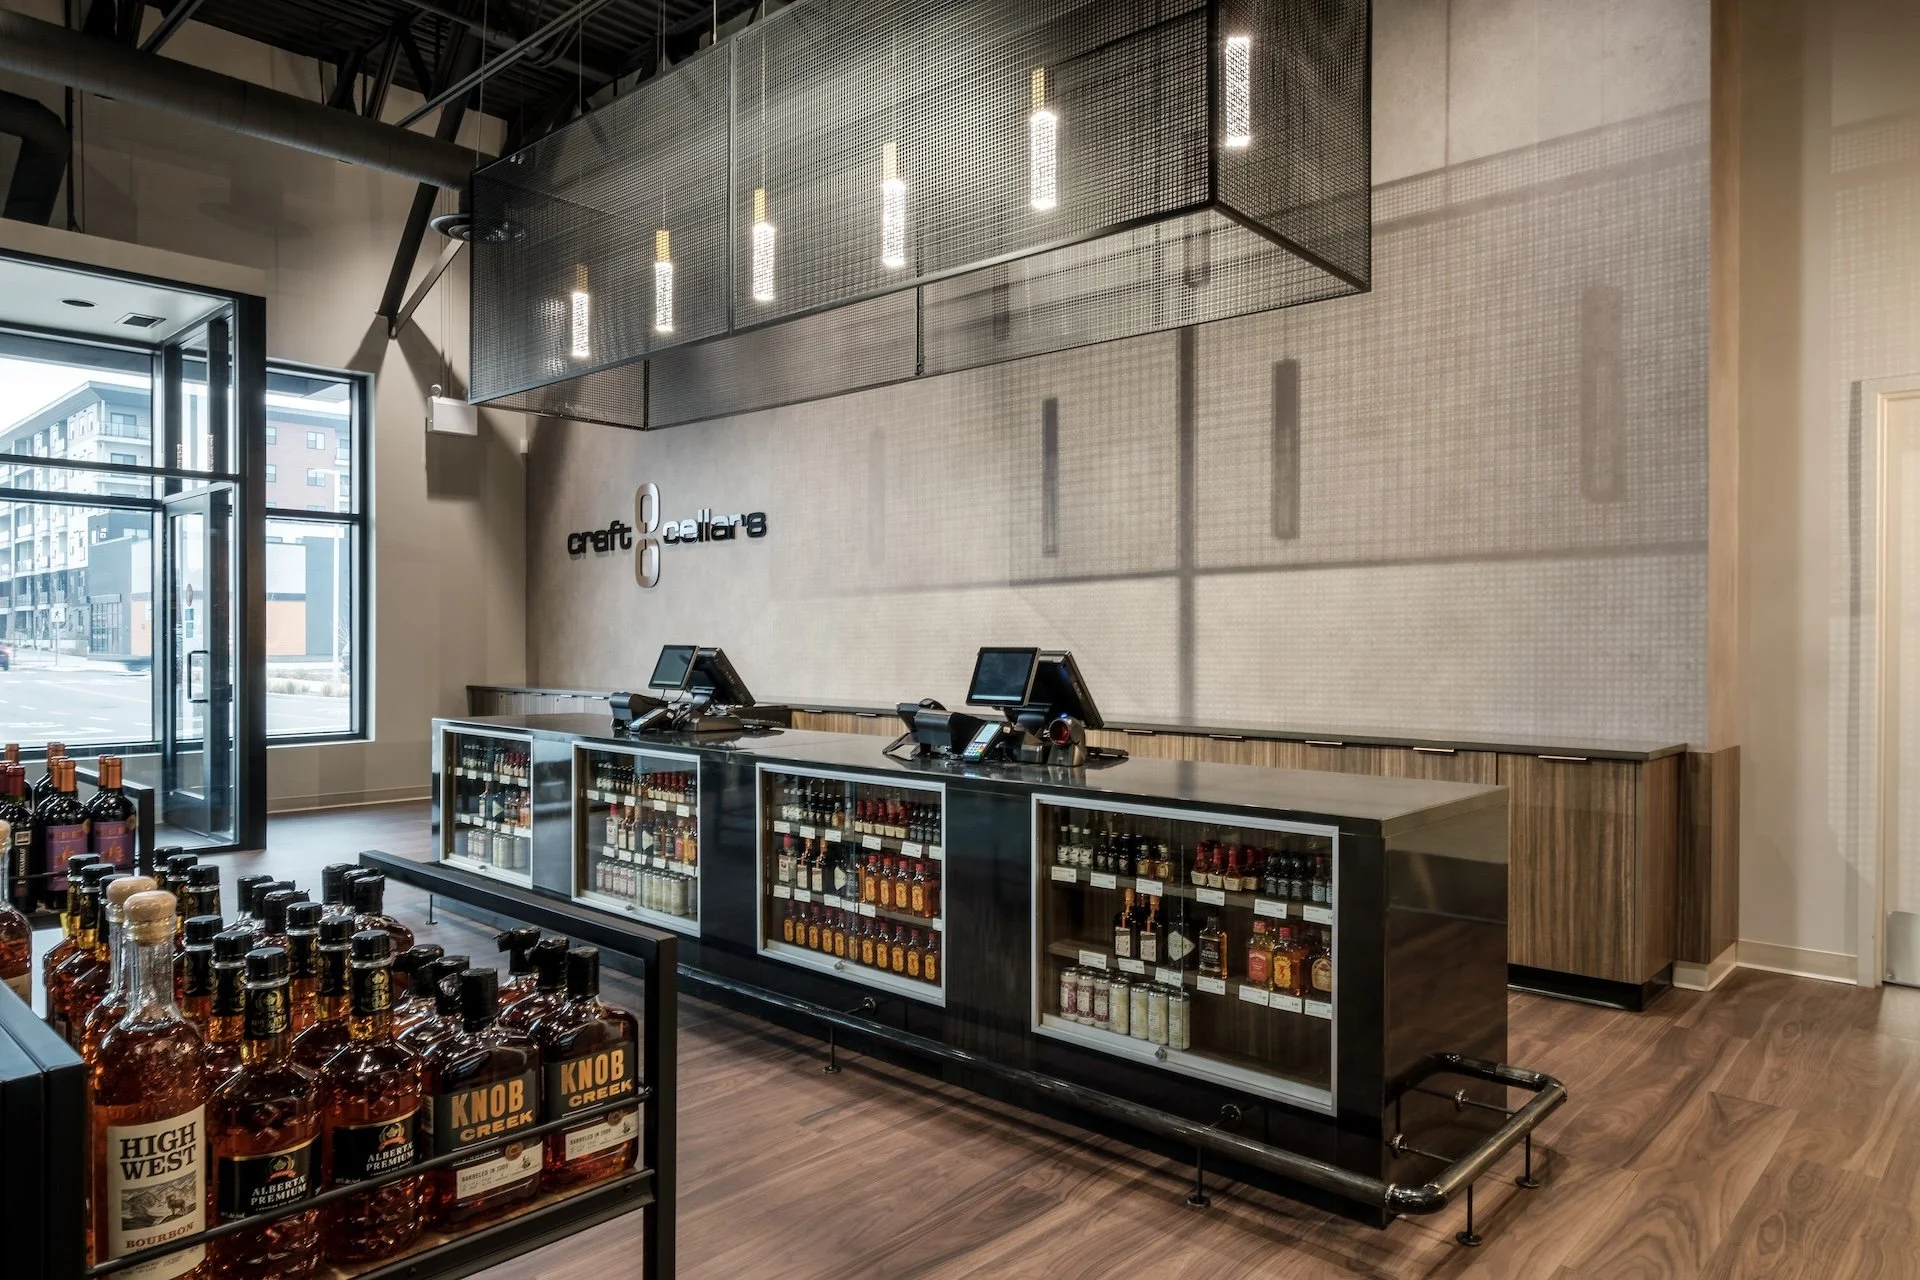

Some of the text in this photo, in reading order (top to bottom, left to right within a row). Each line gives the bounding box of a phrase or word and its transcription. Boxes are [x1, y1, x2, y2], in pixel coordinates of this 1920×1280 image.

[568, 520, 632, 555] craft
[561, 1049, 624, 1096] KNOB
[451, 1079, 524, 1129] KNOB
[568, 1078, 633, 1108] CREEK
[119, 1121, 197, 1160] HIGH
[460, 1109, 534, 1141] CREEK
[119, 1144, 197, 1181] WEST
[366, 1149, 414, 1171] PREMIUM
[367, 1141, 413, 1162] ALBERTA
[250, 1183, 307, 1206] PREMIUM
[252, 1174, 307, 1197] ALBERTA
[125, 1222, 195, 1249] BOURBON
